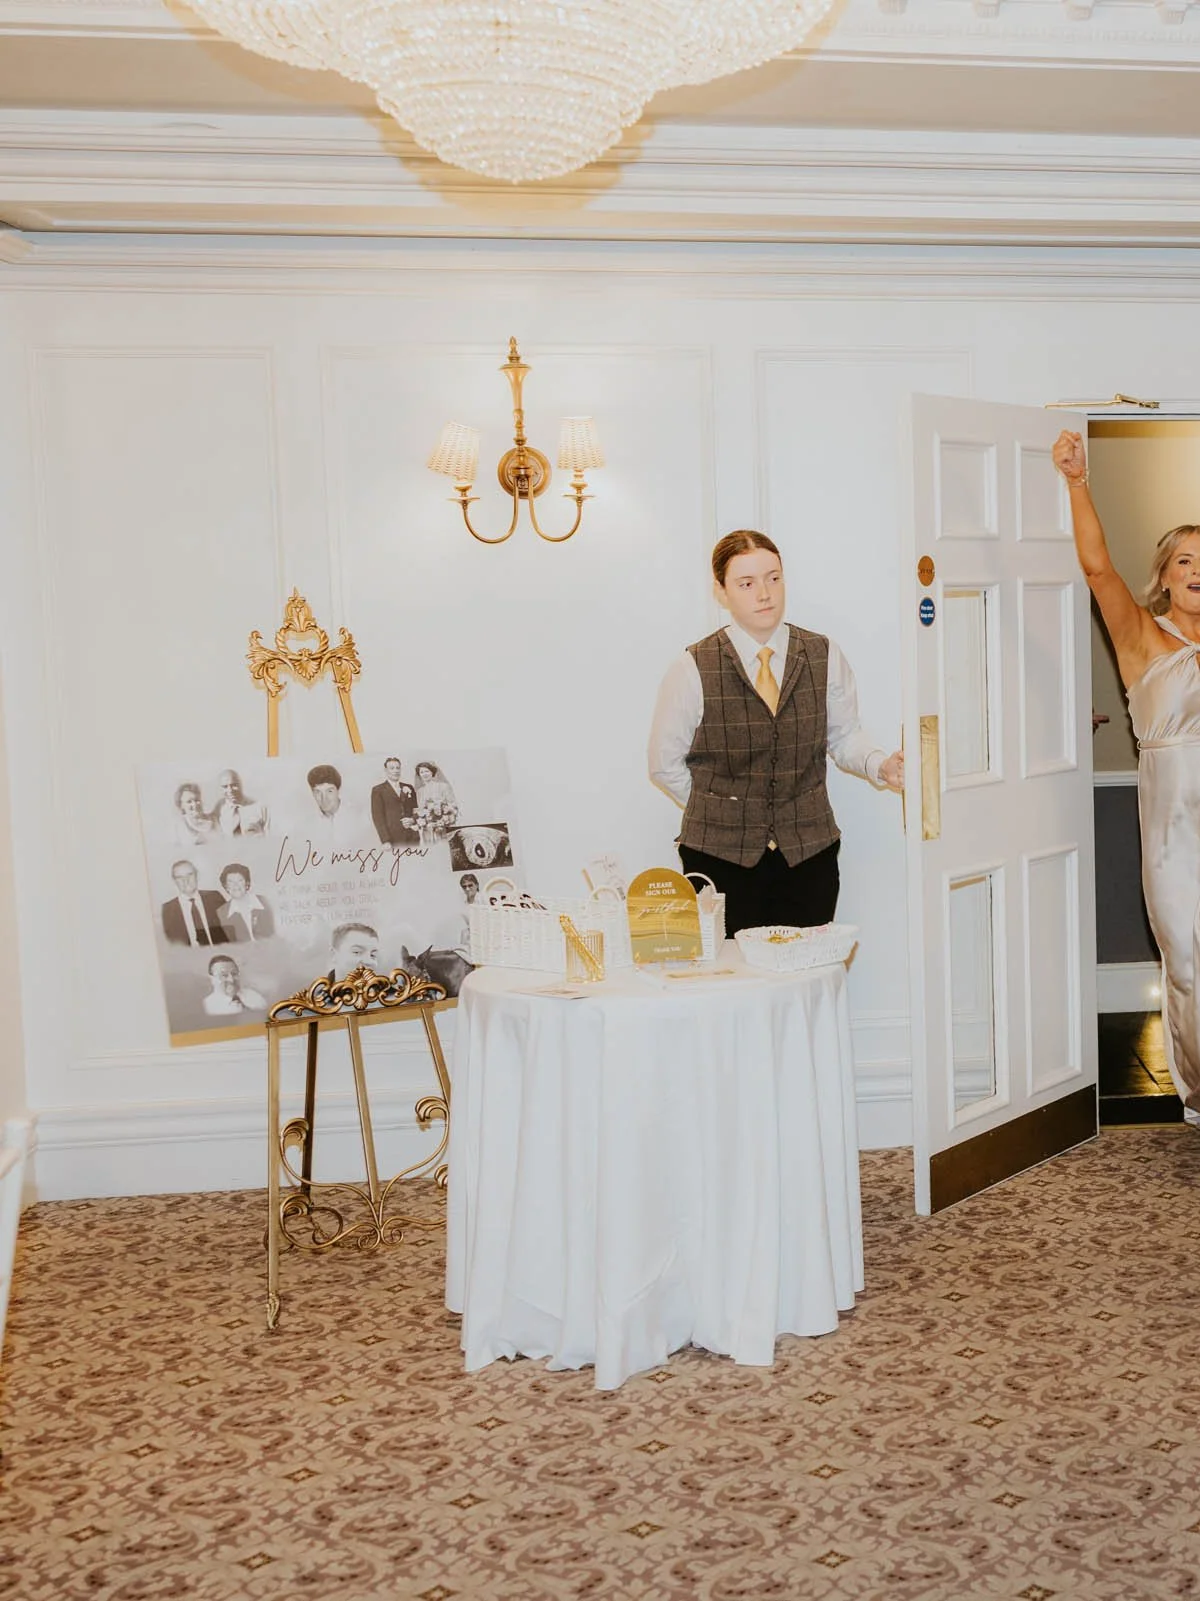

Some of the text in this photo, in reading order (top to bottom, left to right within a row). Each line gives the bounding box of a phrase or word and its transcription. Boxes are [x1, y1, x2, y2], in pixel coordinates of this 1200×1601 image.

[275, 835, 429, 887] We miss you
[648, 881, 673, 889] PLEASE
[645, 888, 677, 897] SIGN OUR
